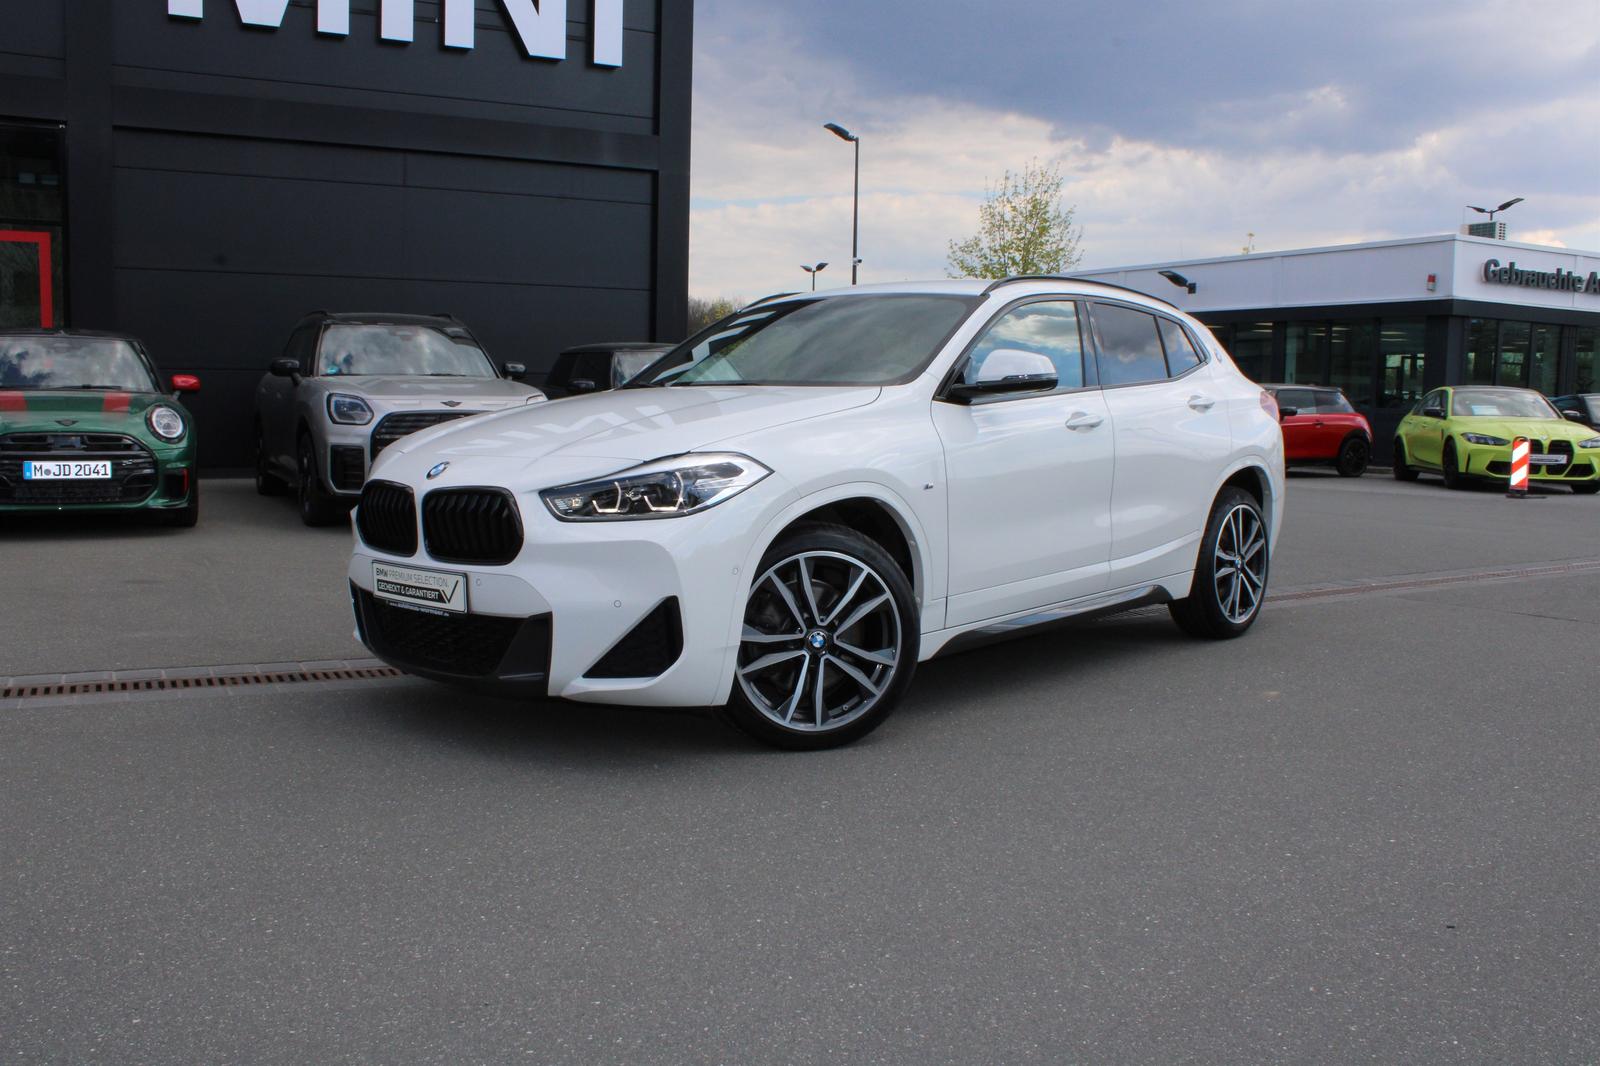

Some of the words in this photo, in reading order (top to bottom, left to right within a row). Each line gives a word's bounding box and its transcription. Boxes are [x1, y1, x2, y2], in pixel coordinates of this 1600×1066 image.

[1484, 259, 1584, 292] Gebrauchte
[1584, 271, 1600, 295] A
[34, 464, 43, 476] M
[53, 464, 71, 476] JD
[75, 464, 109, 476] 2041
[376, 567, 388, 577] BMW
[389, 568, 412, 581] PREMIUM
[378, 582, 400, 593] GECHECKT
[406, 587, 439, 599] GARANTIERT
